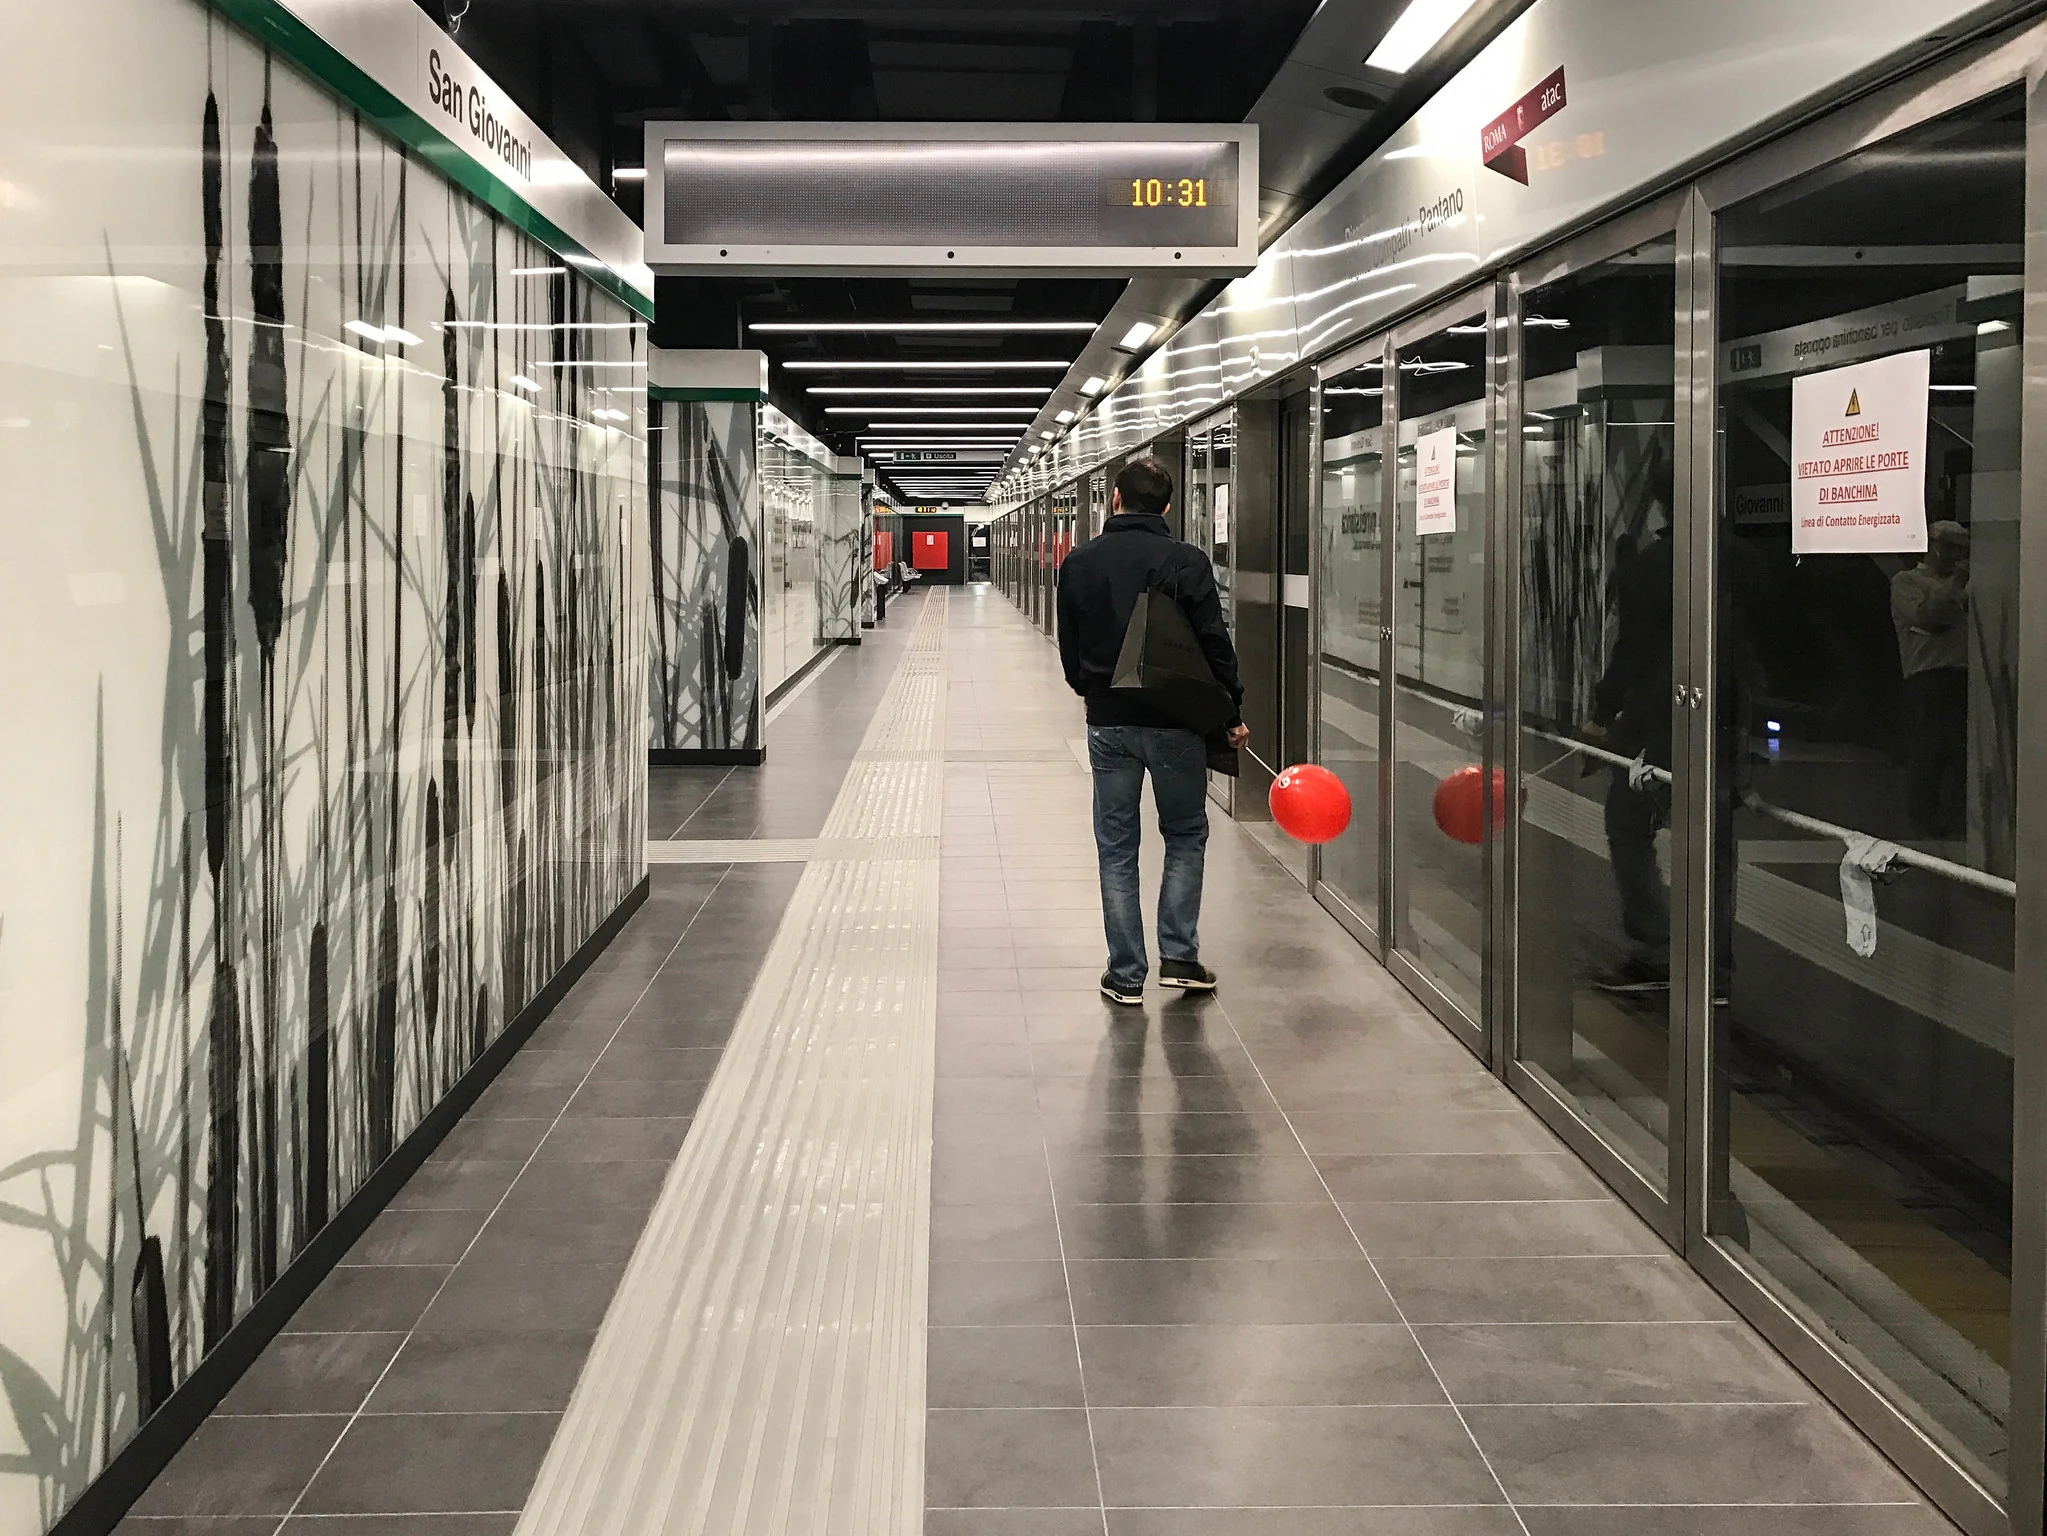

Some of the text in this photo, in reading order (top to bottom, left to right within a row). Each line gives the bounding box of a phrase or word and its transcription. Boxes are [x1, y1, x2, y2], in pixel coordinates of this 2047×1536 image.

[1541, 82, 1562, 112] atac
[429, 48, 532, 183] San Giovanni
[1483, 123, 1507, 154] ROMA
[1132, 178, 1207, 207] 10:31
[1419, 187, 1464, 238] Pantano
[1822, 422, 1879, 444] ATTENZIONE!
[1798, 450, 1909, 477] VIETATO APRIRE LE PORTE
[1736, 492, 1784, 515] Giovanni
[1820, 483, 1878, 501] DI BANCHINA
[1801, 512, 1901, 528] Linea di Contatto Energizzata
